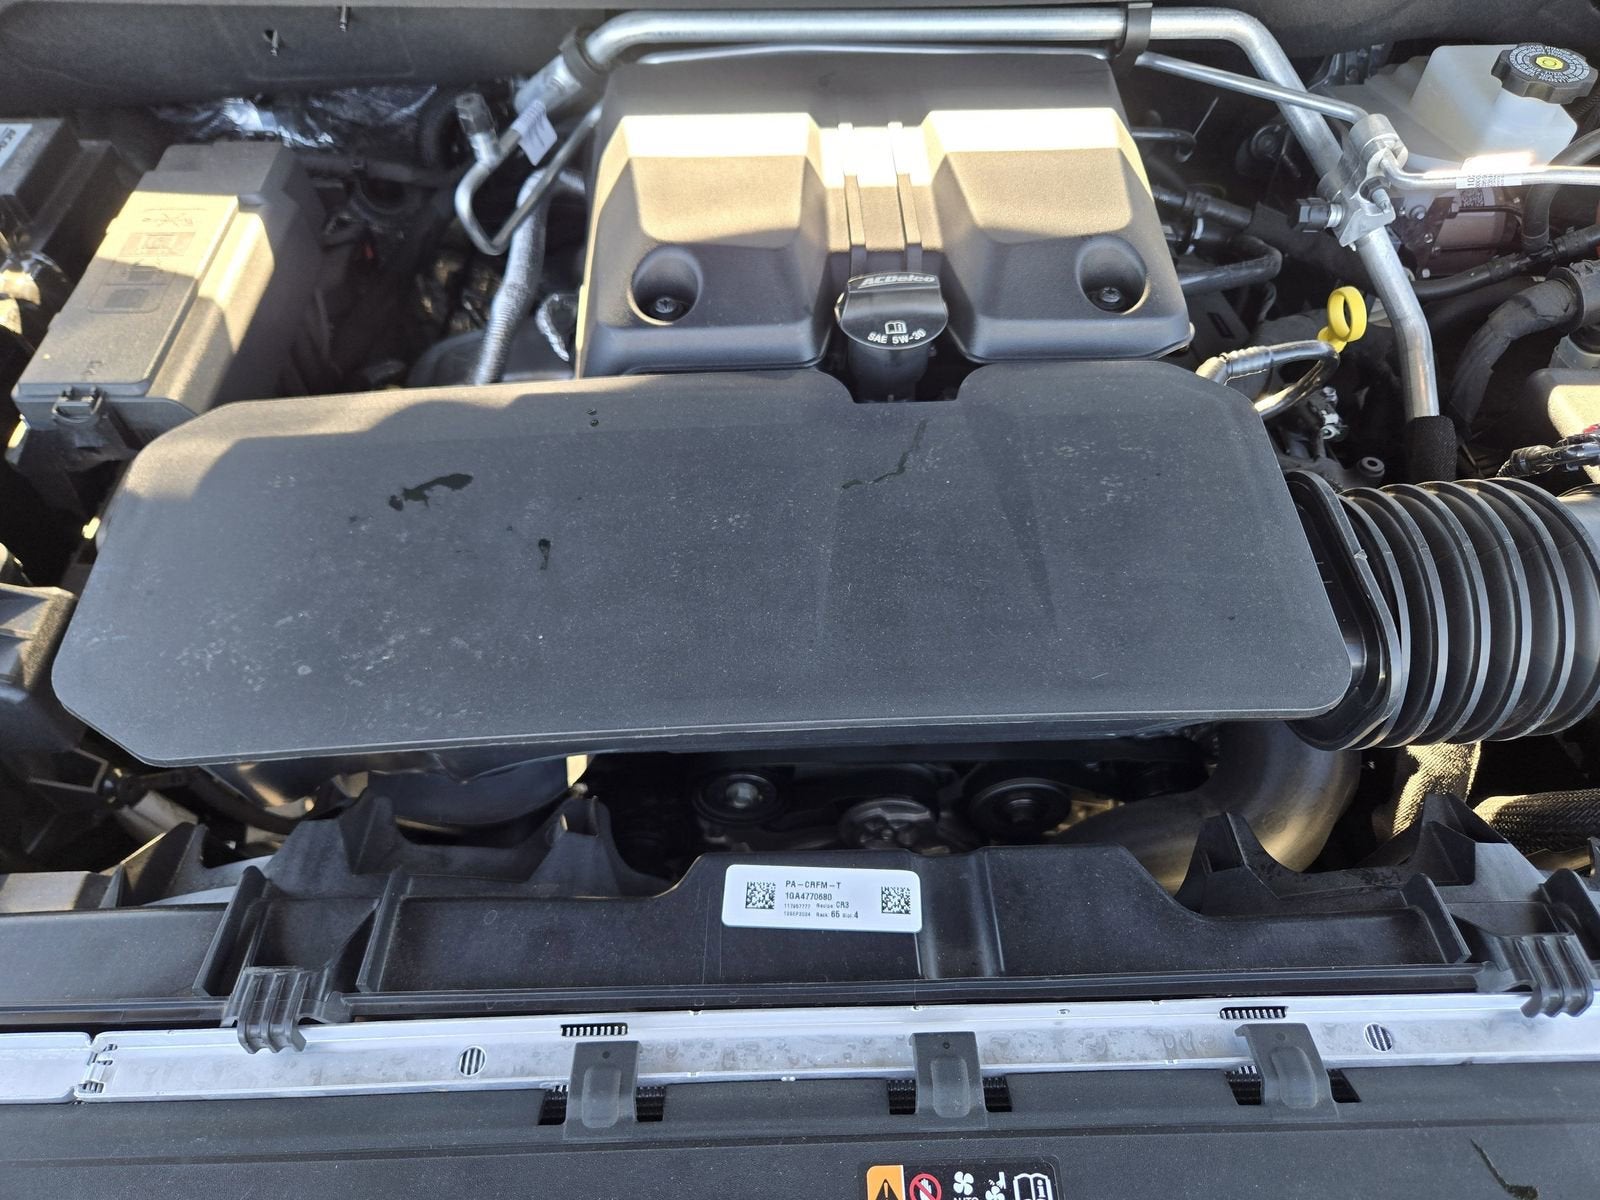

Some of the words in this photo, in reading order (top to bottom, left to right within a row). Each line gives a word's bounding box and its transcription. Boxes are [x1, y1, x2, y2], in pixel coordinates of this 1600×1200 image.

[858, 274, 935, 289] ACDelco
[867, 332, 888, 344] SAE
[892, 328, 926, 344] 5W-30
[835, 901, 850, 909] CR3
[831, 910, 840, 918] 65
[854, 911, 859, 919] 4
